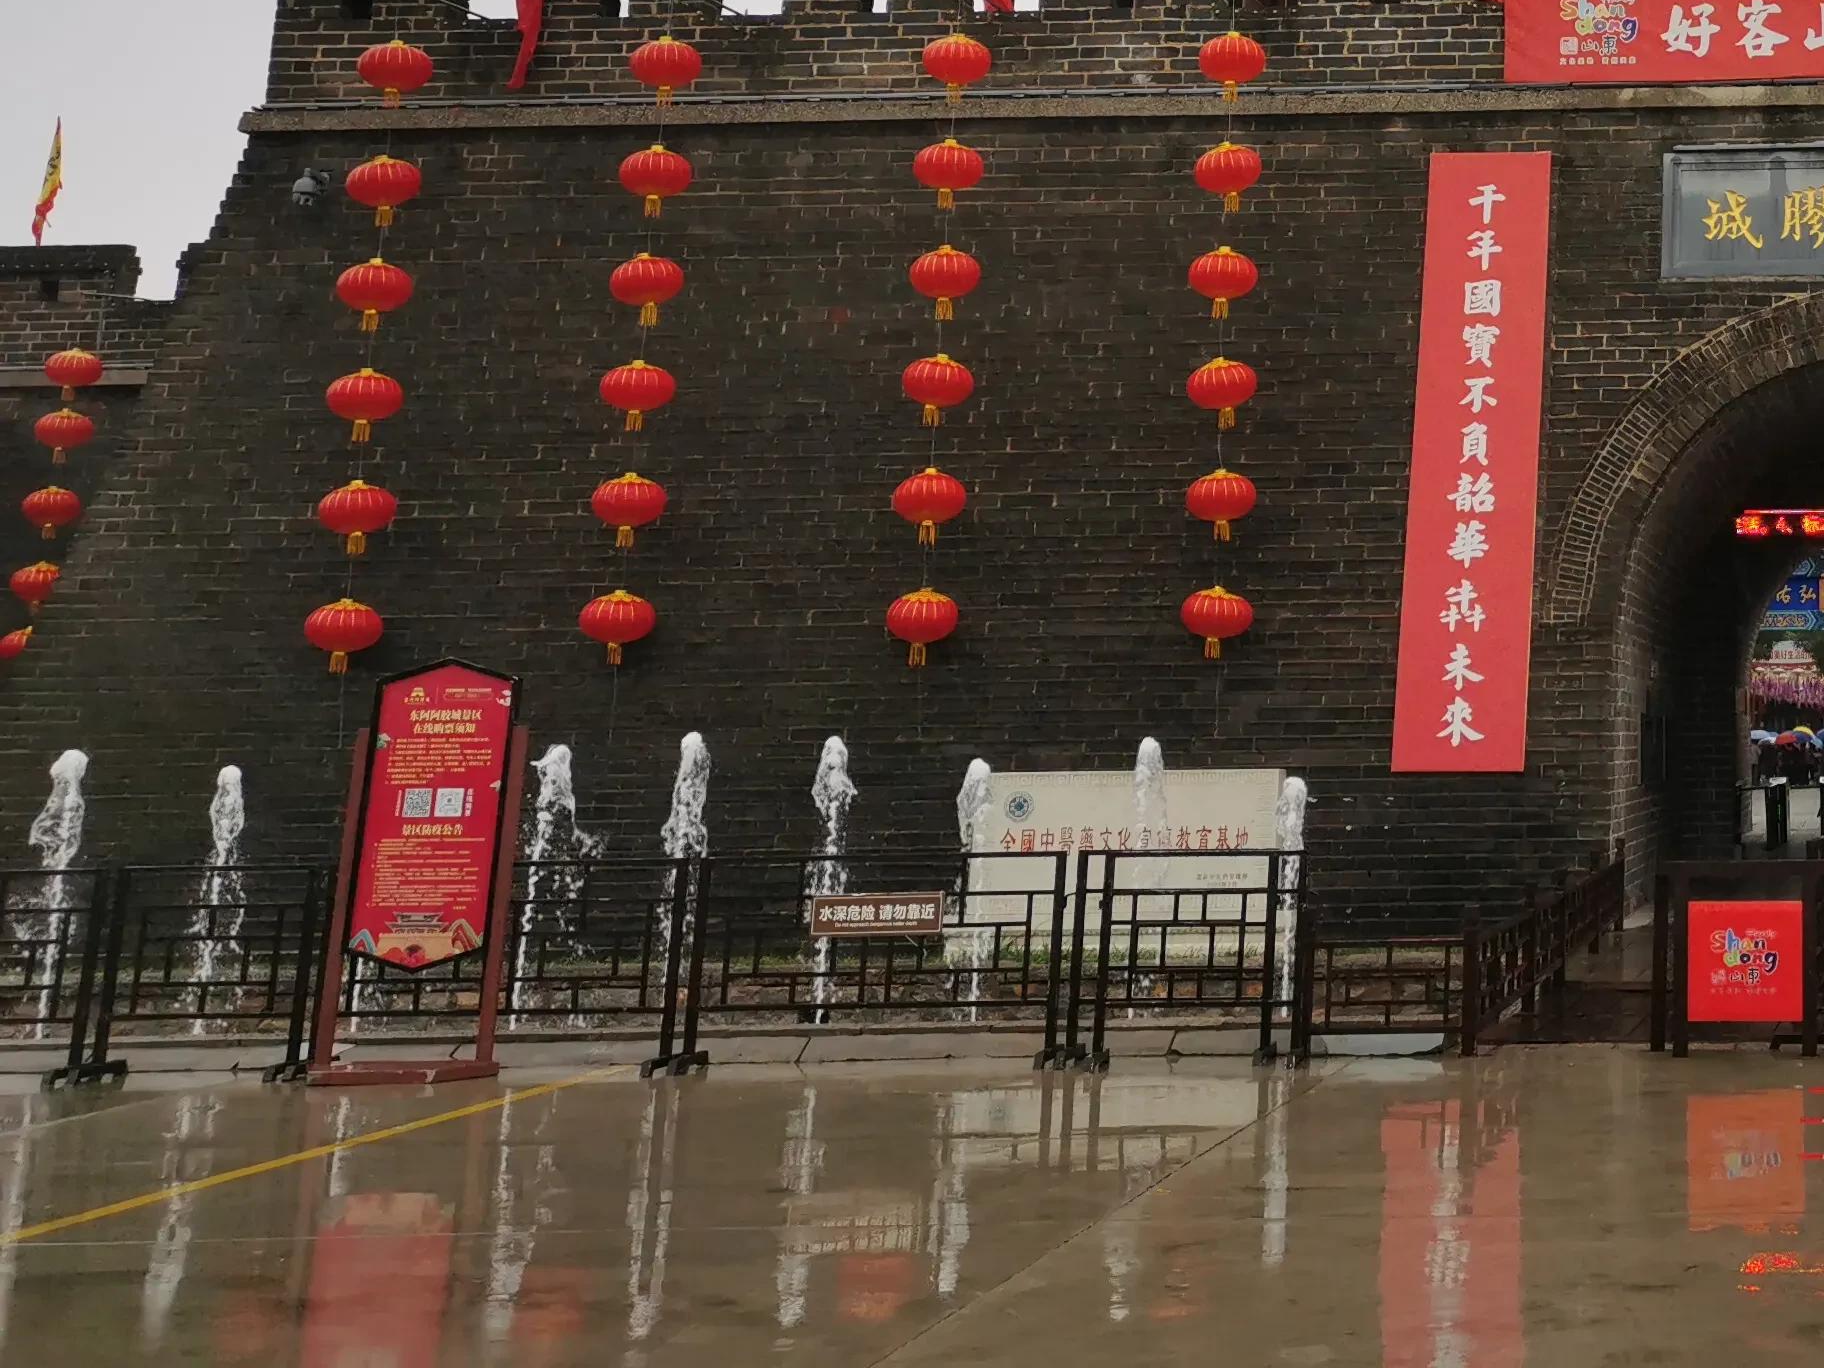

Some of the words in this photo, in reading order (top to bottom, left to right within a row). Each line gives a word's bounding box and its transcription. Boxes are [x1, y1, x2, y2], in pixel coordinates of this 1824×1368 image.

[819, 905, 875, 921] 水深危险
[879, 904, 935, 920] 请勿靠近
